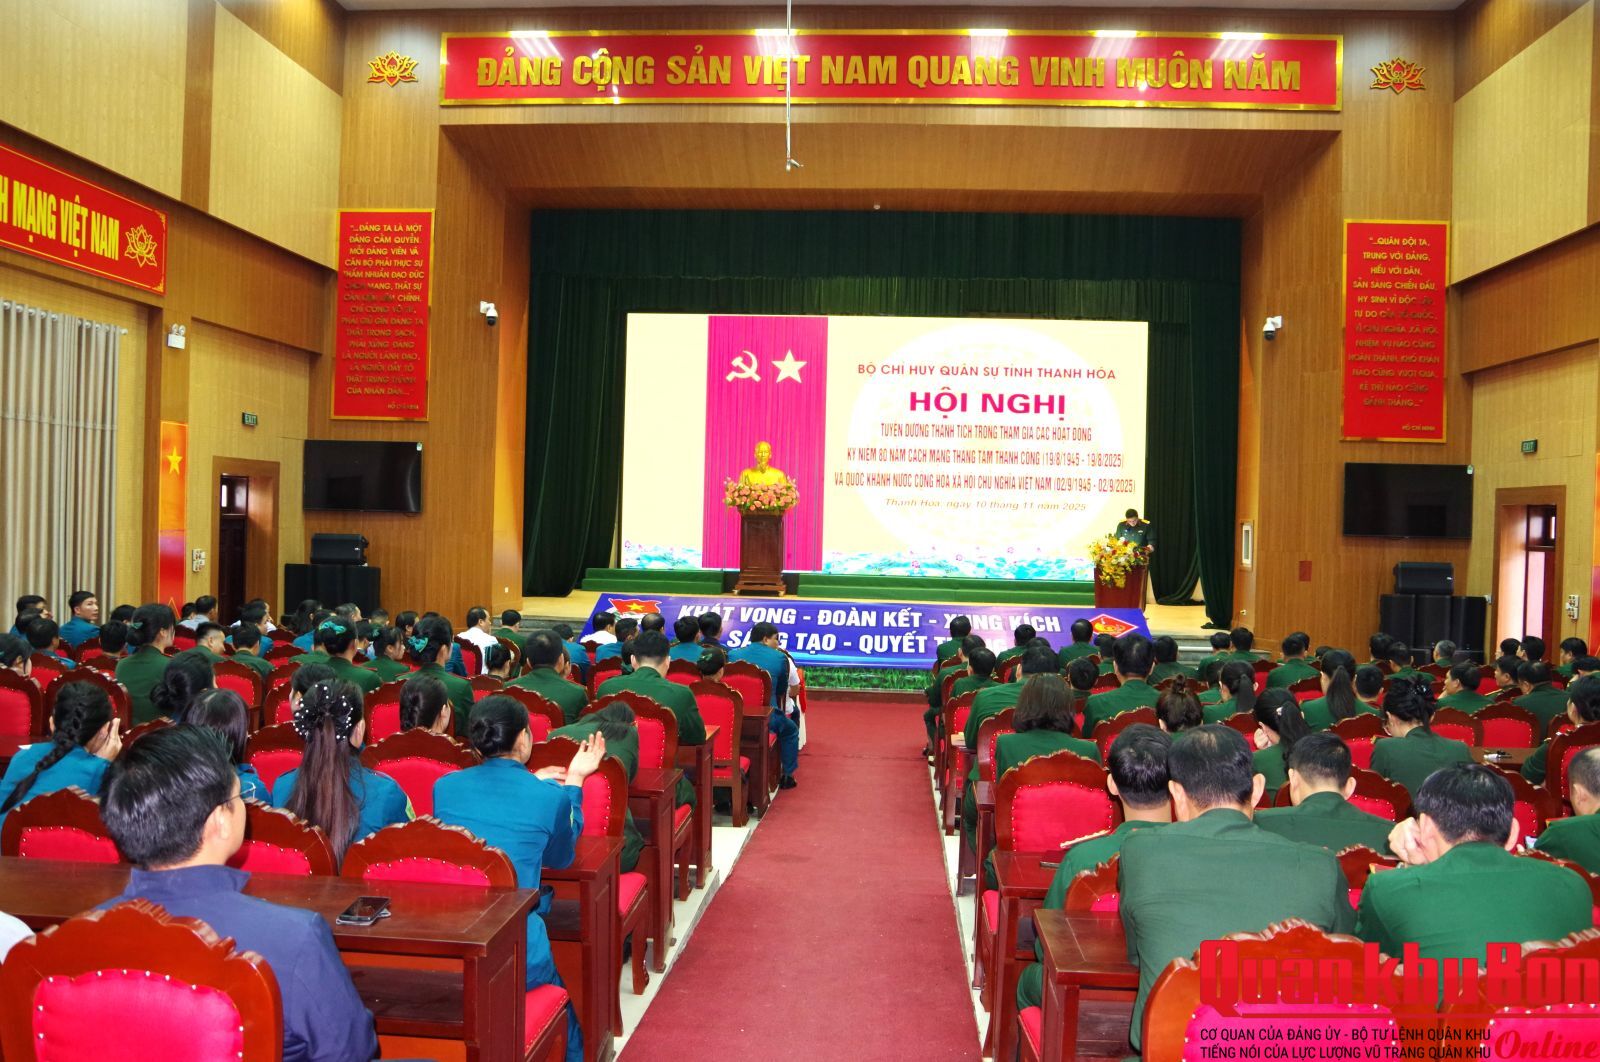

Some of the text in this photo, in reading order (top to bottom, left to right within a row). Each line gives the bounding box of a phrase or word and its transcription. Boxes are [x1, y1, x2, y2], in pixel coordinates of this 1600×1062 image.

[477, 45, 1300, 91] ĐẢNG CỘNG SẢN VIỆT NAM QUANG VINH MUÔN NĂM
[12, 180, 57, 243] MẠNG
[60, 194, 89, 258] VIỆT
[90, 211, 120, 261] NAM
[383, 224, 392, 232] TA
[394, 223, 403, 232] LÀ
[406, 223, 422, 233] MỘT
[1402, 236, 1417, 248] ĐỘI
[1363, 251, 1388, 260] TRUNG
[1365, 310, 1378, 318] DO
[909, 365, 935, 375] HUY
[940, 363, 979, 377] QUÂN
[1037, 367, 1082, 378] THANH
[910, 386, 1065, 421] HỘI NGHỊ
[975, 424, 997, 439] TRONG
[1000, 425, 1020, 440] THAM
[1022, 426, 1034, 440] GIA
[879, 448, 888, 461] 80
[1035, 476, 1052, 491] NAM
[741, 607, 797, 625] VỌNG
[817, 607, 877, 628] ĐOÀN
[883, 607, 923, 628] KẾT
[796, 632, 837, 655] TẠO
[859, 630, 928, 654] QUYẾT
